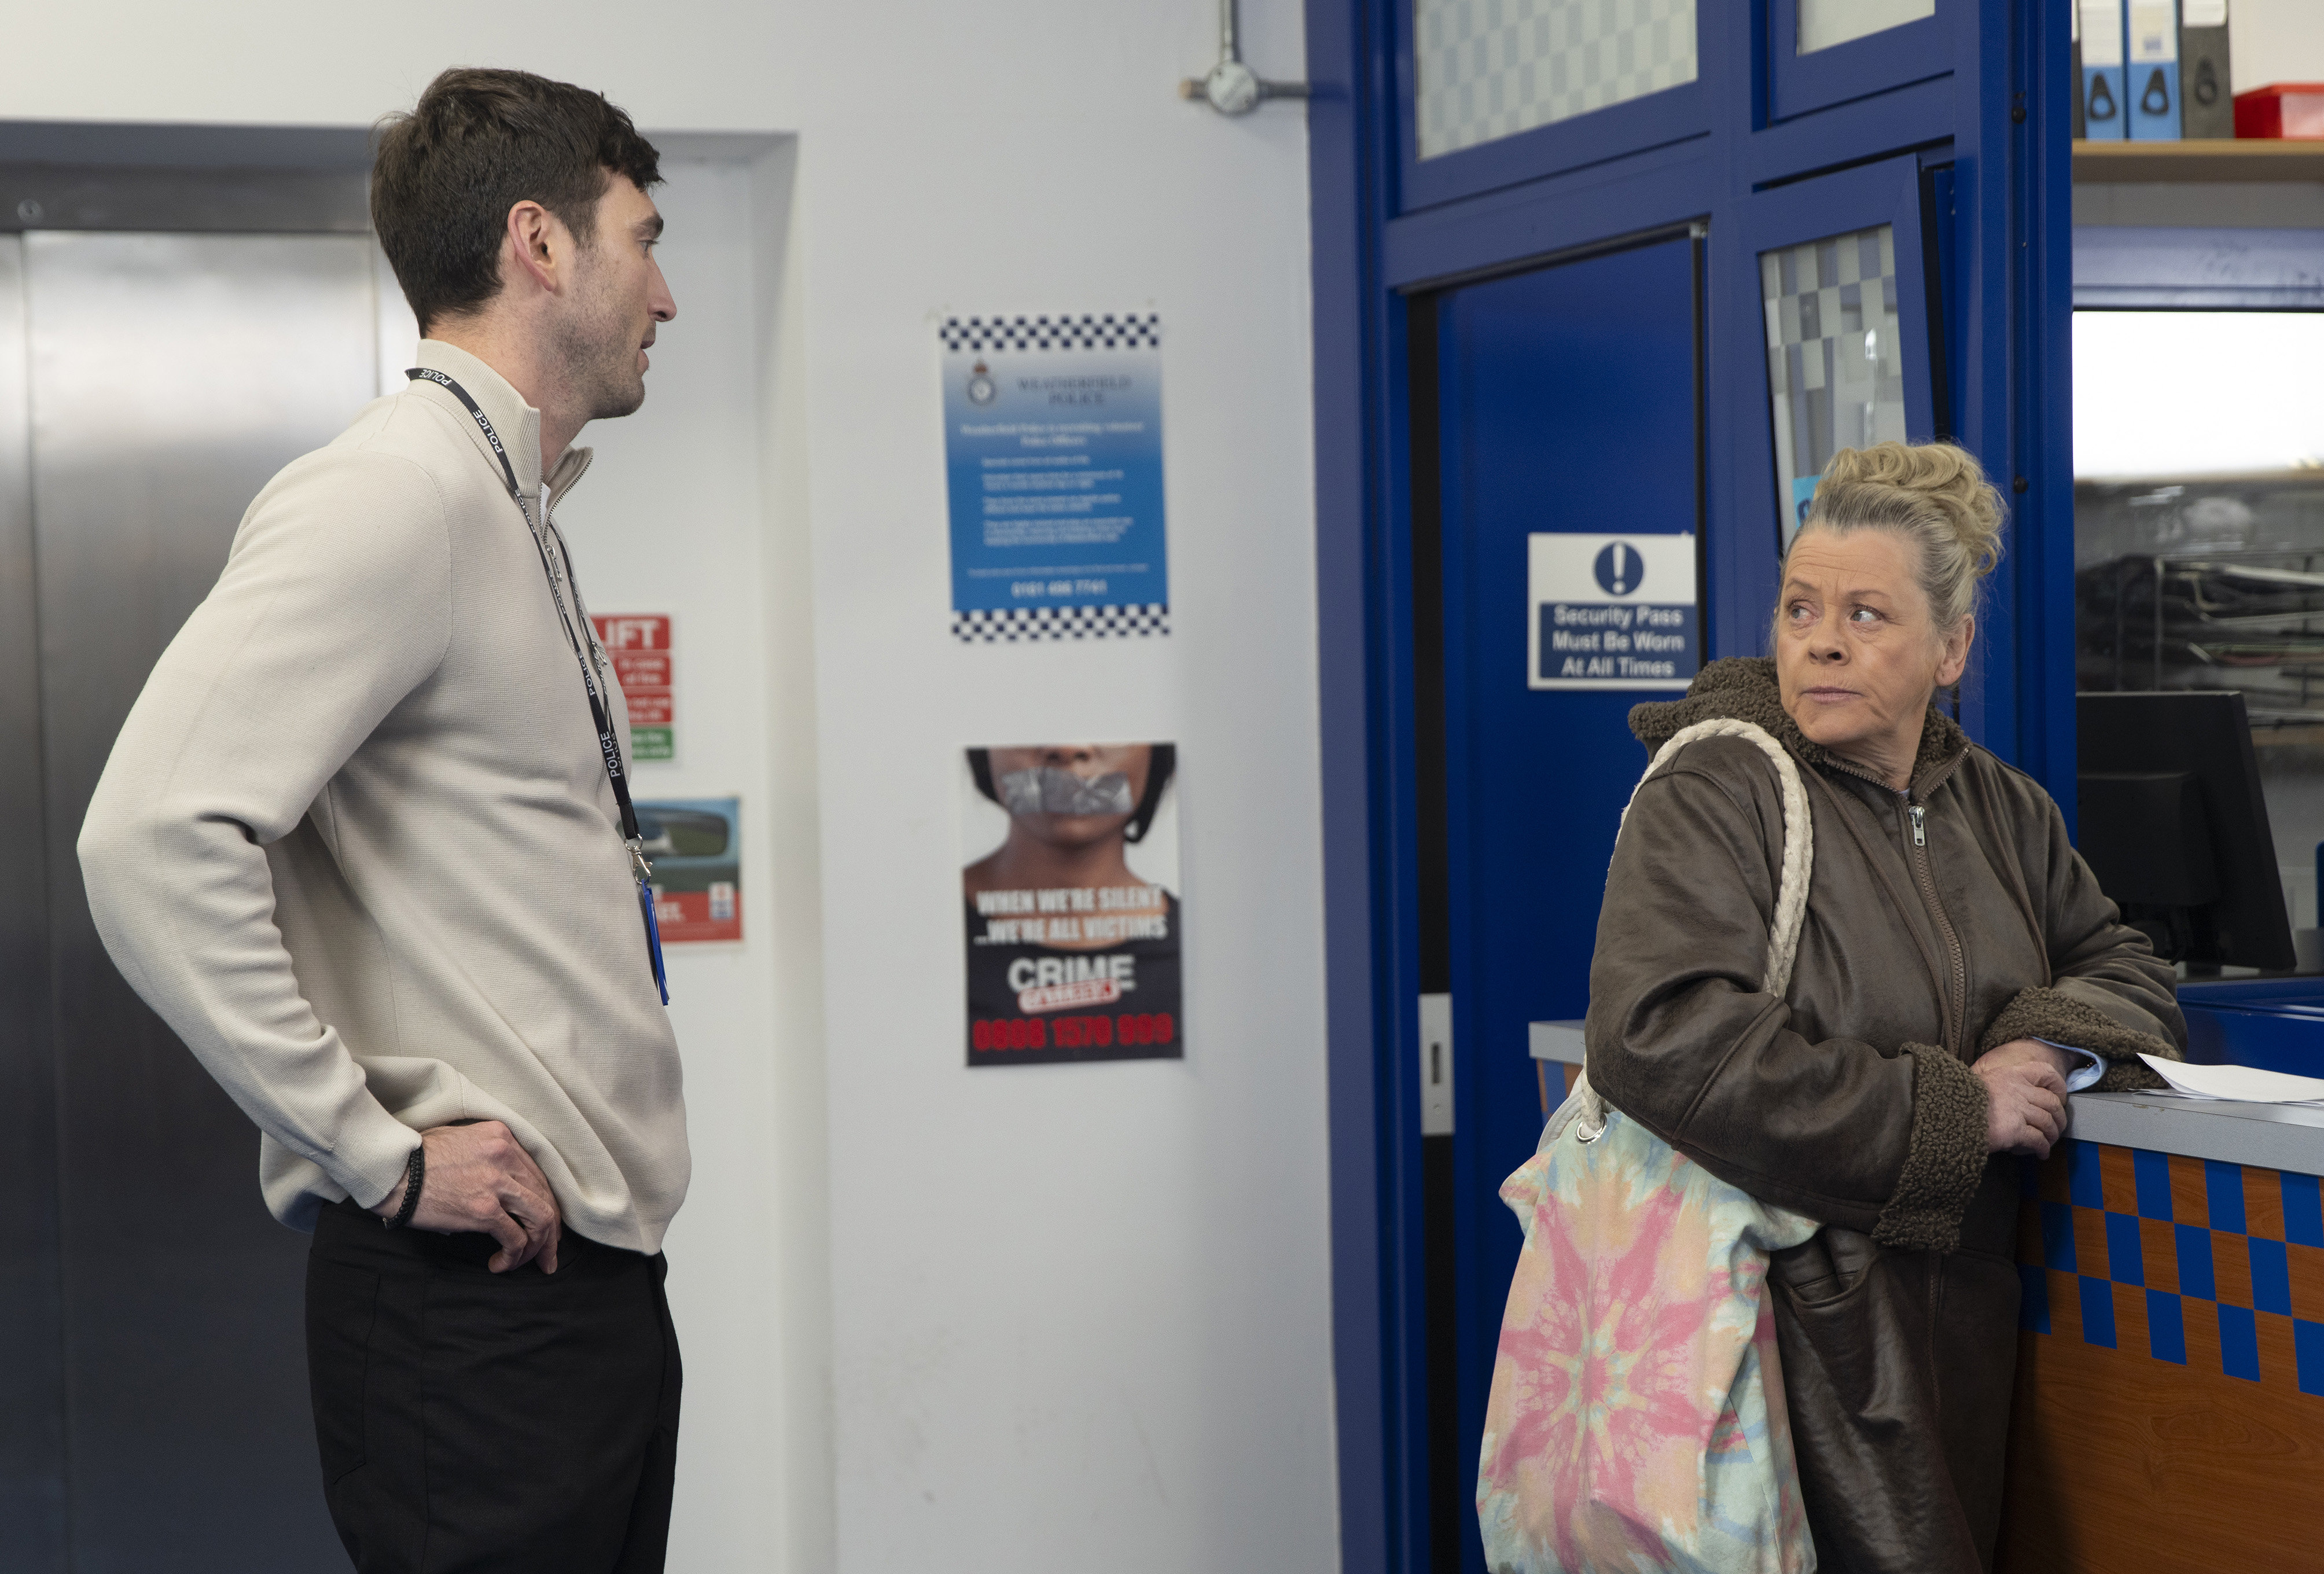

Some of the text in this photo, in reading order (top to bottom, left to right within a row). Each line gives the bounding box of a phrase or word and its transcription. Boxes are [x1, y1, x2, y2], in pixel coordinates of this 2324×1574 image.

[419, 369, 452, 386] POLICE
[1049, 391, 1106, 405] POLICE
[473, 409, 502, 453] POLICE
[514, 488, 535, 533] POLICE
[1554, 604, 1683, 630] Security Pass
[603, 619, 660, 646] IFT
[1553, 630, 1685, 652] Must Be Worn
[578, 650, 595, 696] POLICE
[1561, 656, 1675, 677] At All Times
[601, 731, 620, 777] POLICE
[977, 886, 1163, 915] WHEN WE'RE SILENT
[1049, 918, 1079, 941] ALL
[1083, 915, 1167, 940] VICTIMS
[1007, 954, 1137, 993] CRIME
[1051, 1015, 1112, 1049] 1570
